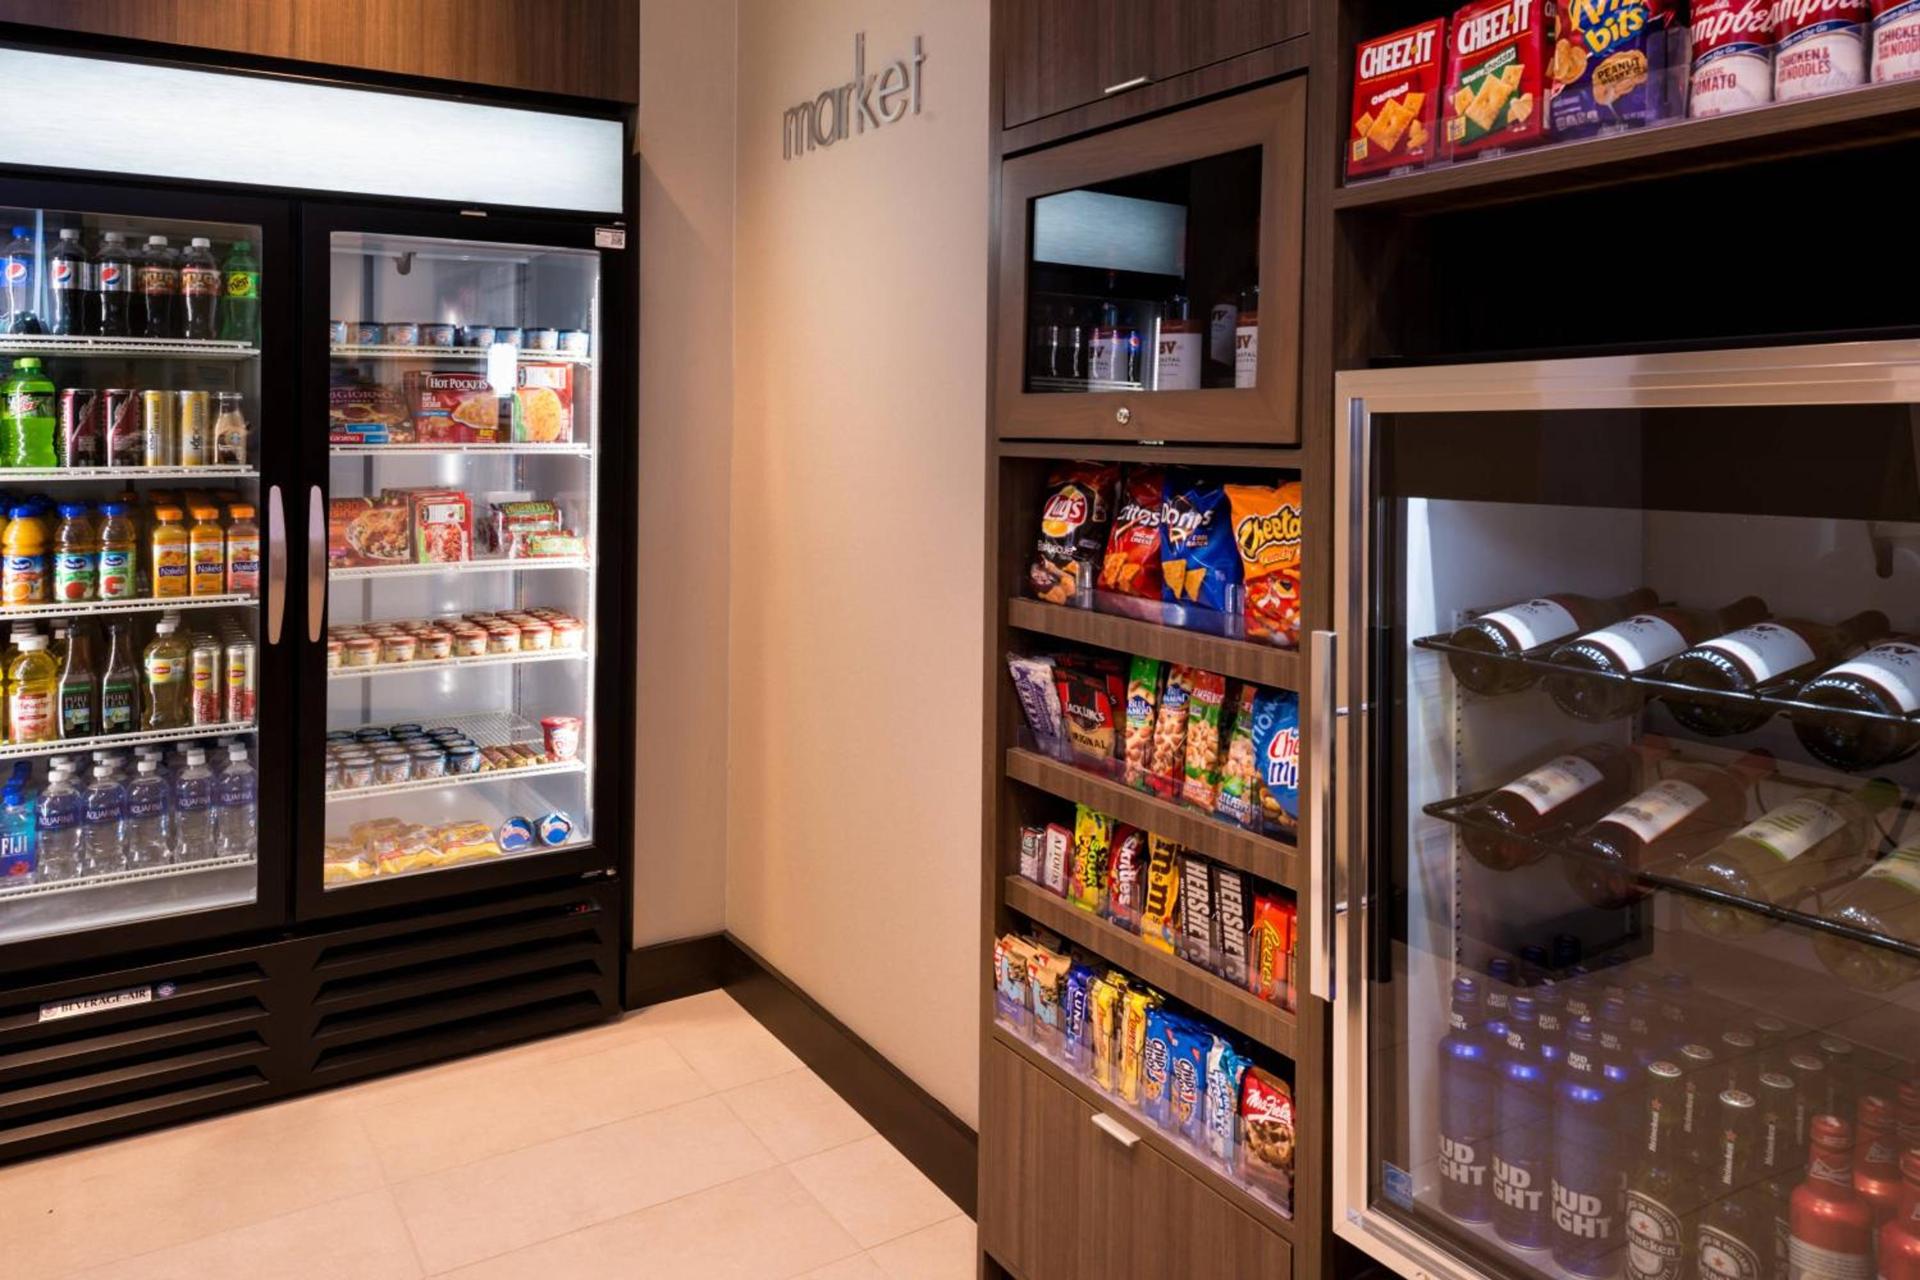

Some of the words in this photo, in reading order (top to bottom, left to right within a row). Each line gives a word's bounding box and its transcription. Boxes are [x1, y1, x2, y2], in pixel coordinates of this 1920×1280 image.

[1879, 25, 1920, 45] CHICKE
[783, 32, 927, 161] market
[430, 378, 449, 389] HOT
[449, 378, 489, 390] POCKETS
[1238, 506, 1301, 556] Cheeto
[1, 835, 28, 856] FIJI
[1087, 840, 1099, 887] SOUR
[1117, 832, 1138, 906] Skittles
[1073, 988, 1084, 1032] LUNA
[1440, 1134, 1475, 1164] UD
[1439, 1155, 1487, 1186] GHT
[1493, 1176, 1543, 1212] GHT
